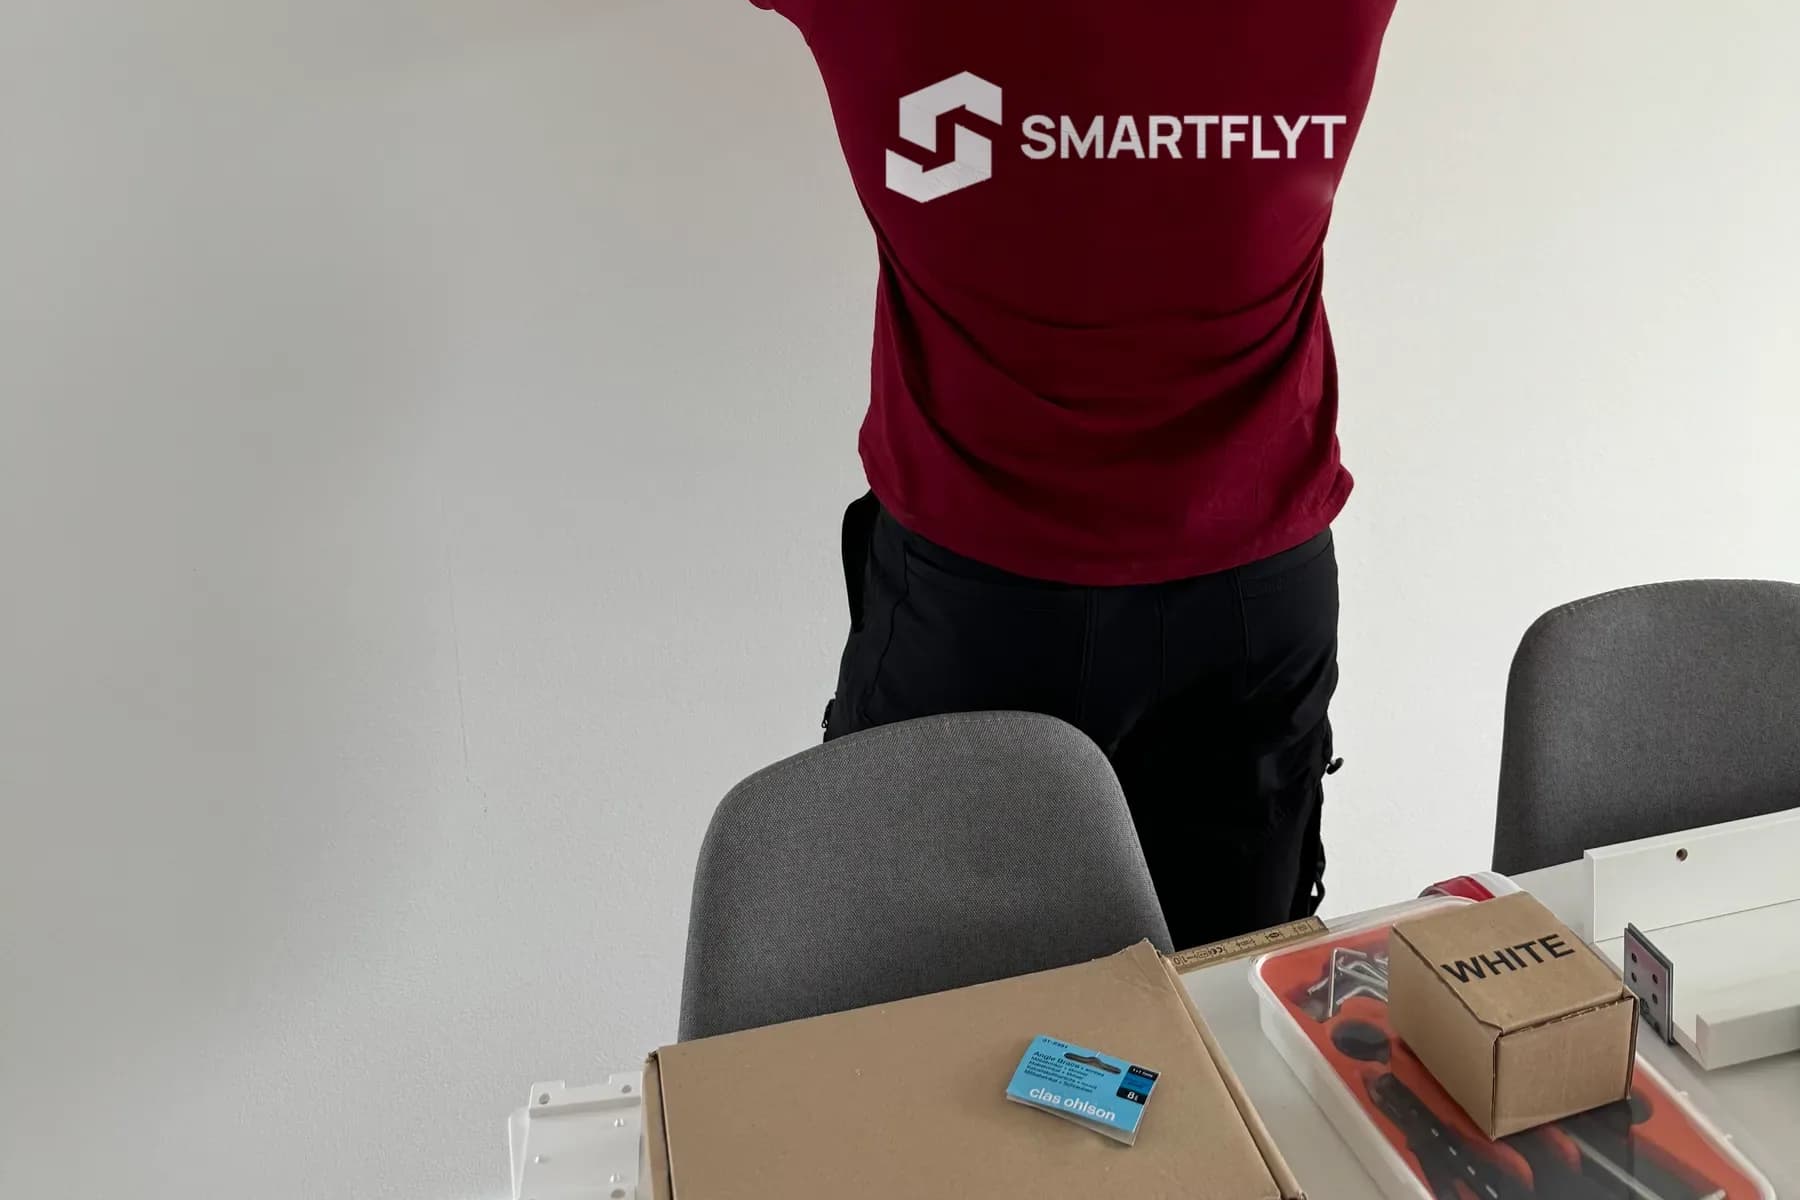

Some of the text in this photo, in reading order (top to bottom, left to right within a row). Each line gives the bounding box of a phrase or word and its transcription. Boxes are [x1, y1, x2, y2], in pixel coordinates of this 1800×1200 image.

[1021, 114, 1347, 160] SMARTFLYT
[1440, 933, 1576, 984] WHITE
[1029, 1087, 1116, 1122] clas ohlson
